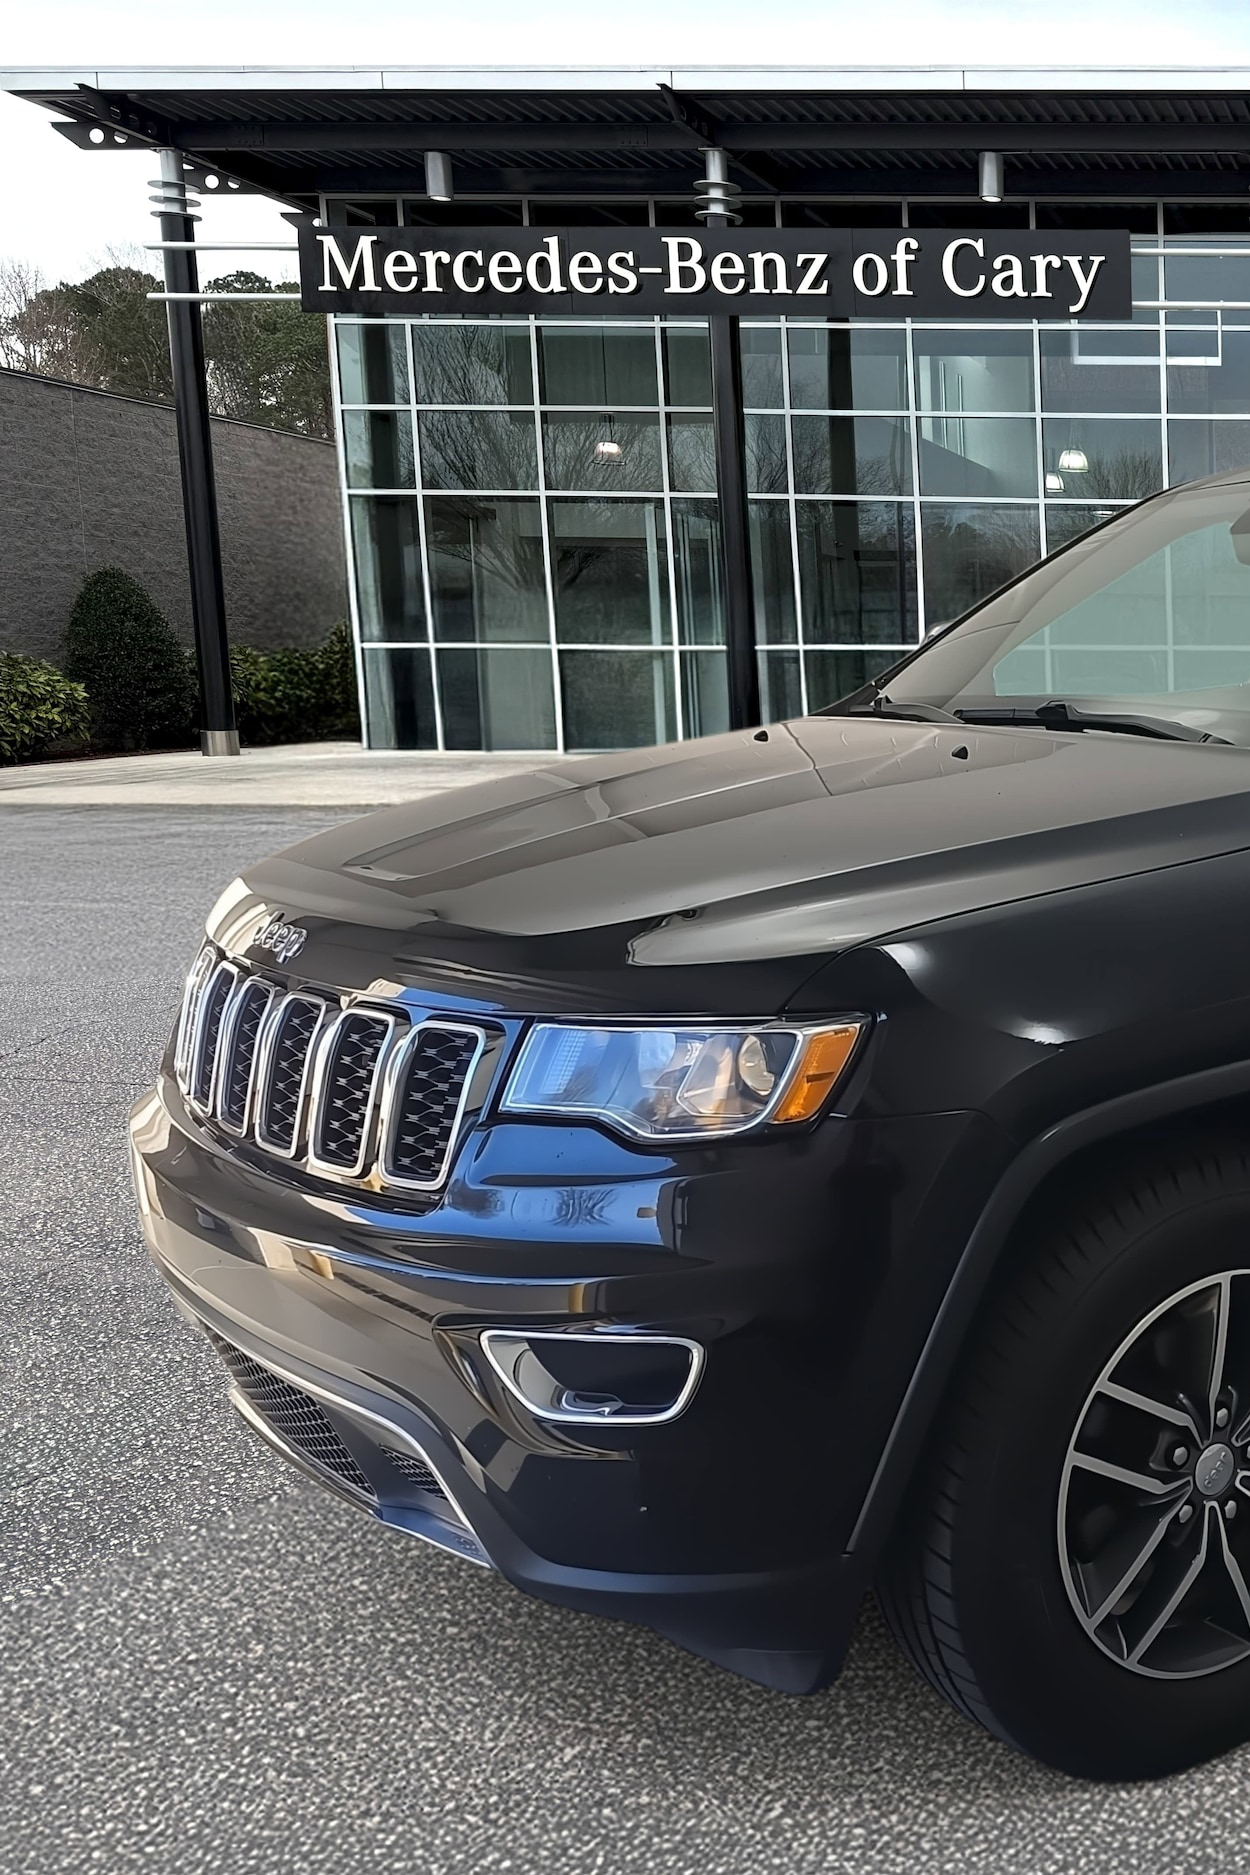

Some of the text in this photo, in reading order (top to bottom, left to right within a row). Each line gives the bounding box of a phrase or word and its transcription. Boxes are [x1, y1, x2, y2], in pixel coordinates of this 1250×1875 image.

[316, 235, 1106, 313] Mercedes-Benz of Cary
[253, 910, 307, 964] Jeep
